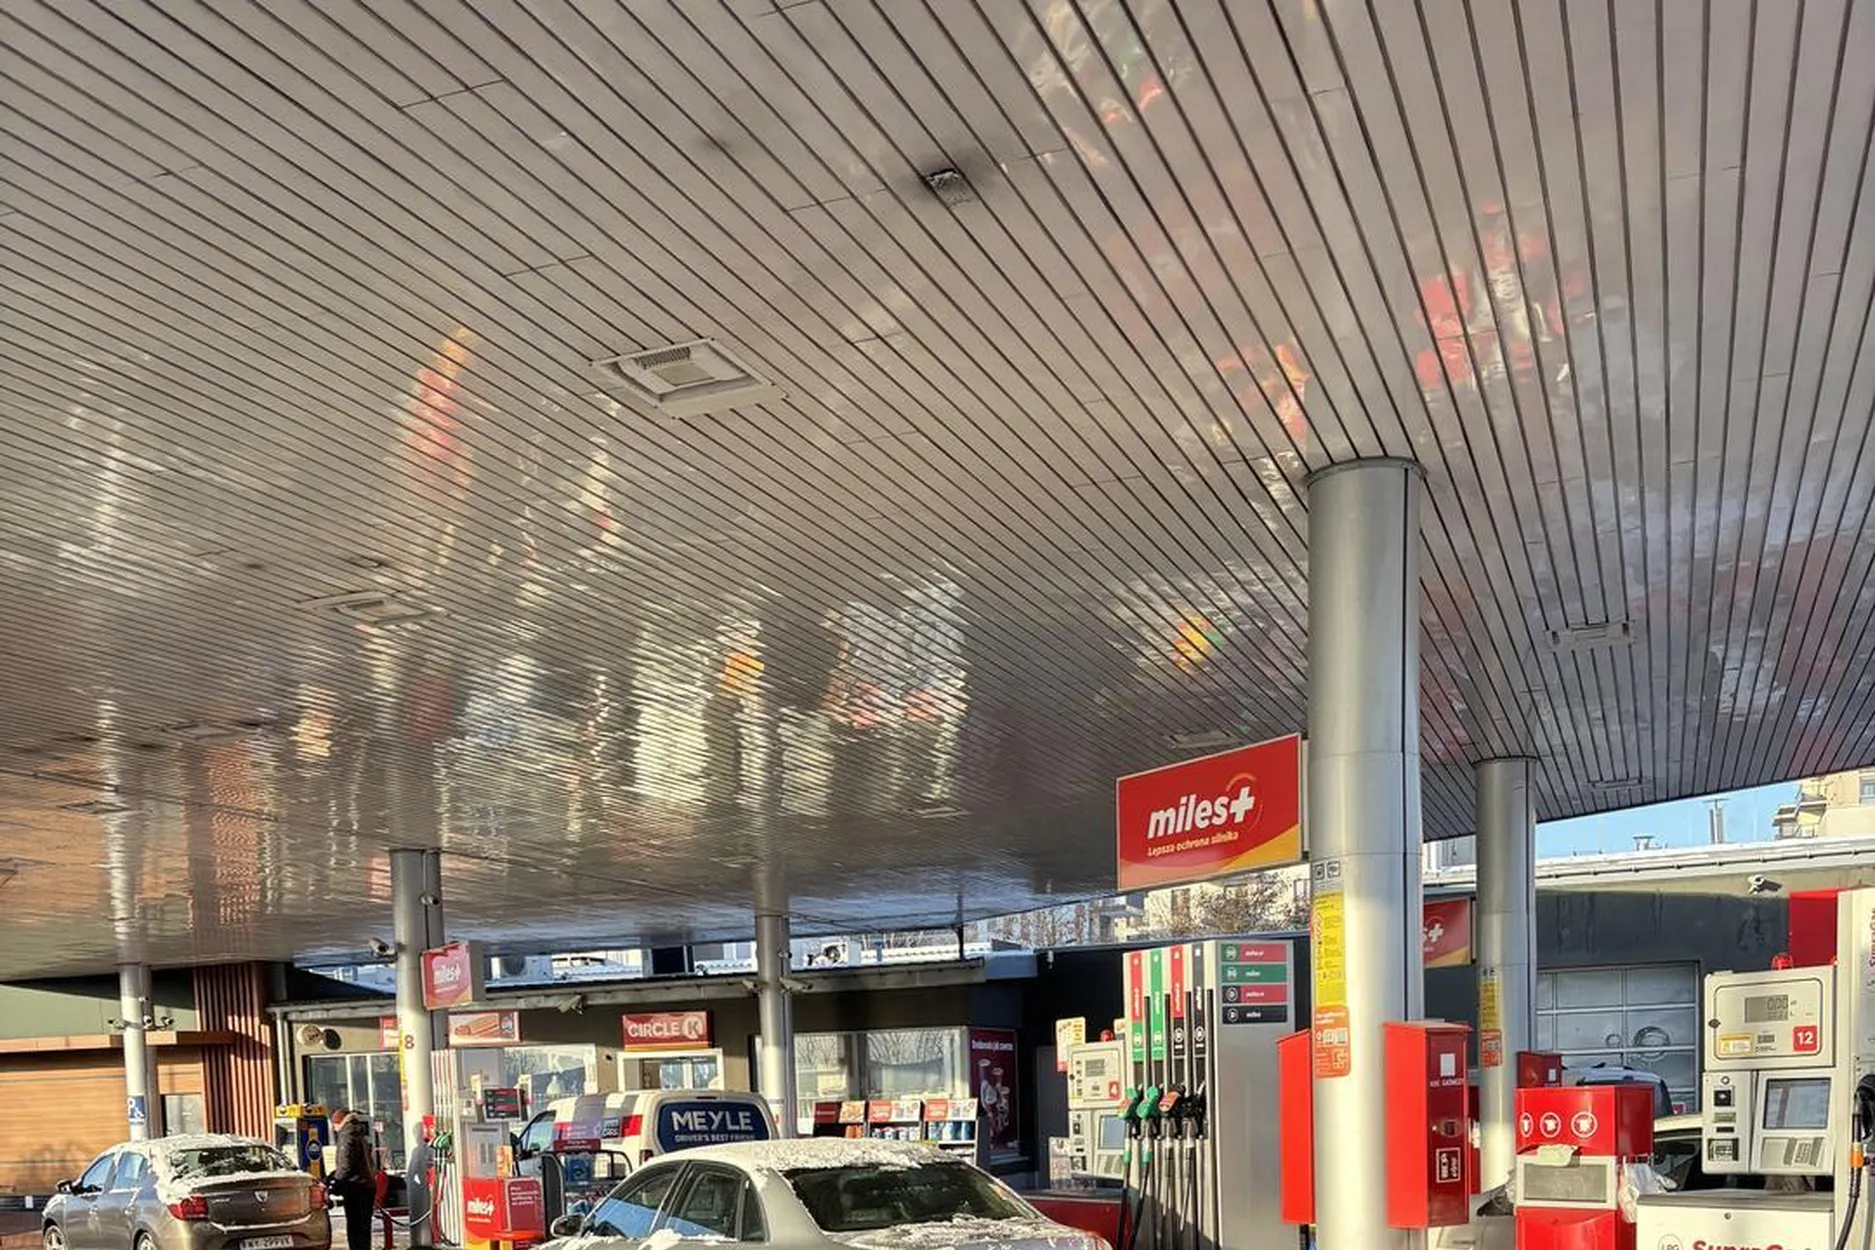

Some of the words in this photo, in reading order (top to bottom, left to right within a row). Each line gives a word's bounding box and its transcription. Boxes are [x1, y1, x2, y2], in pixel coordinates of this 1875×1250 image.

[1147, 786, 1256, 839] miles+
[1176, 837, 1210, 852] ochrona
[627, 1022, 680, 1037] CIRCLE
[404, 1034, 415, 1049] 8
[1798, 1032, 1814, 1045] 12
[1110, 1083, 1119, 1097] 4
[672, 1111, 754, 1131] MEYLE
[711, 1134, 728, 1142] BEST
